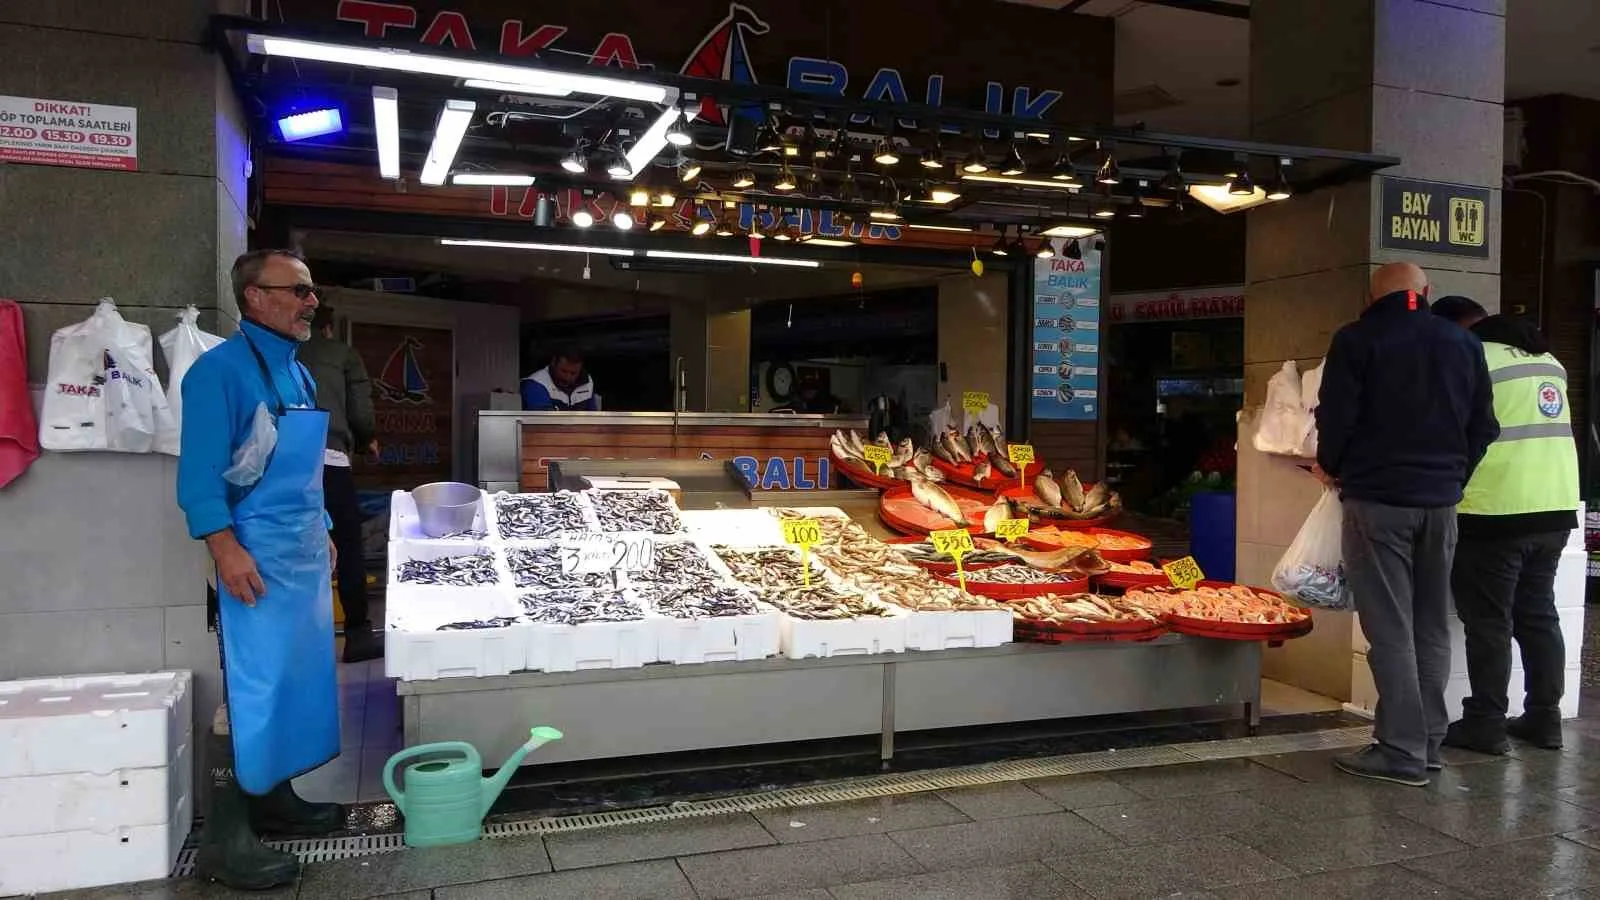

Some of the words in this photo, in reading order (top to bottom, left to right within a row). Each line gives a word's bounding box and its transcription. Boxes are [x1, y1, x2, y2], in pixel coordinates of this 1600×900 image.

[336, 0, 640, 70] TAKA
[34, 102, 91, 117] DİKKAT!
[0, 110, 17, 122] ÖP
[20, 113, 76, 128] TOPLAMA
[78, 119, 131, 133] SAATLERİ
[47, 130, 81, 142] 15.30
[94, 134, 127, 146] 19.30
[1402, 191, 1432, 216] BAY
[1391, 215, 1441, 243] BAYAN
[1458, 231, 1475, 243] WC
[1049, 258, 1086, 273] TAKA
[1047, 274, 1089, 289] BALIK
[732, 455, 830, 490] BALI
[790, 525, 819, 545] 100
[938, 535, 972, 552] 350
[563, 546, 581, 572] 3
[609, 537, 652, 571] 200
